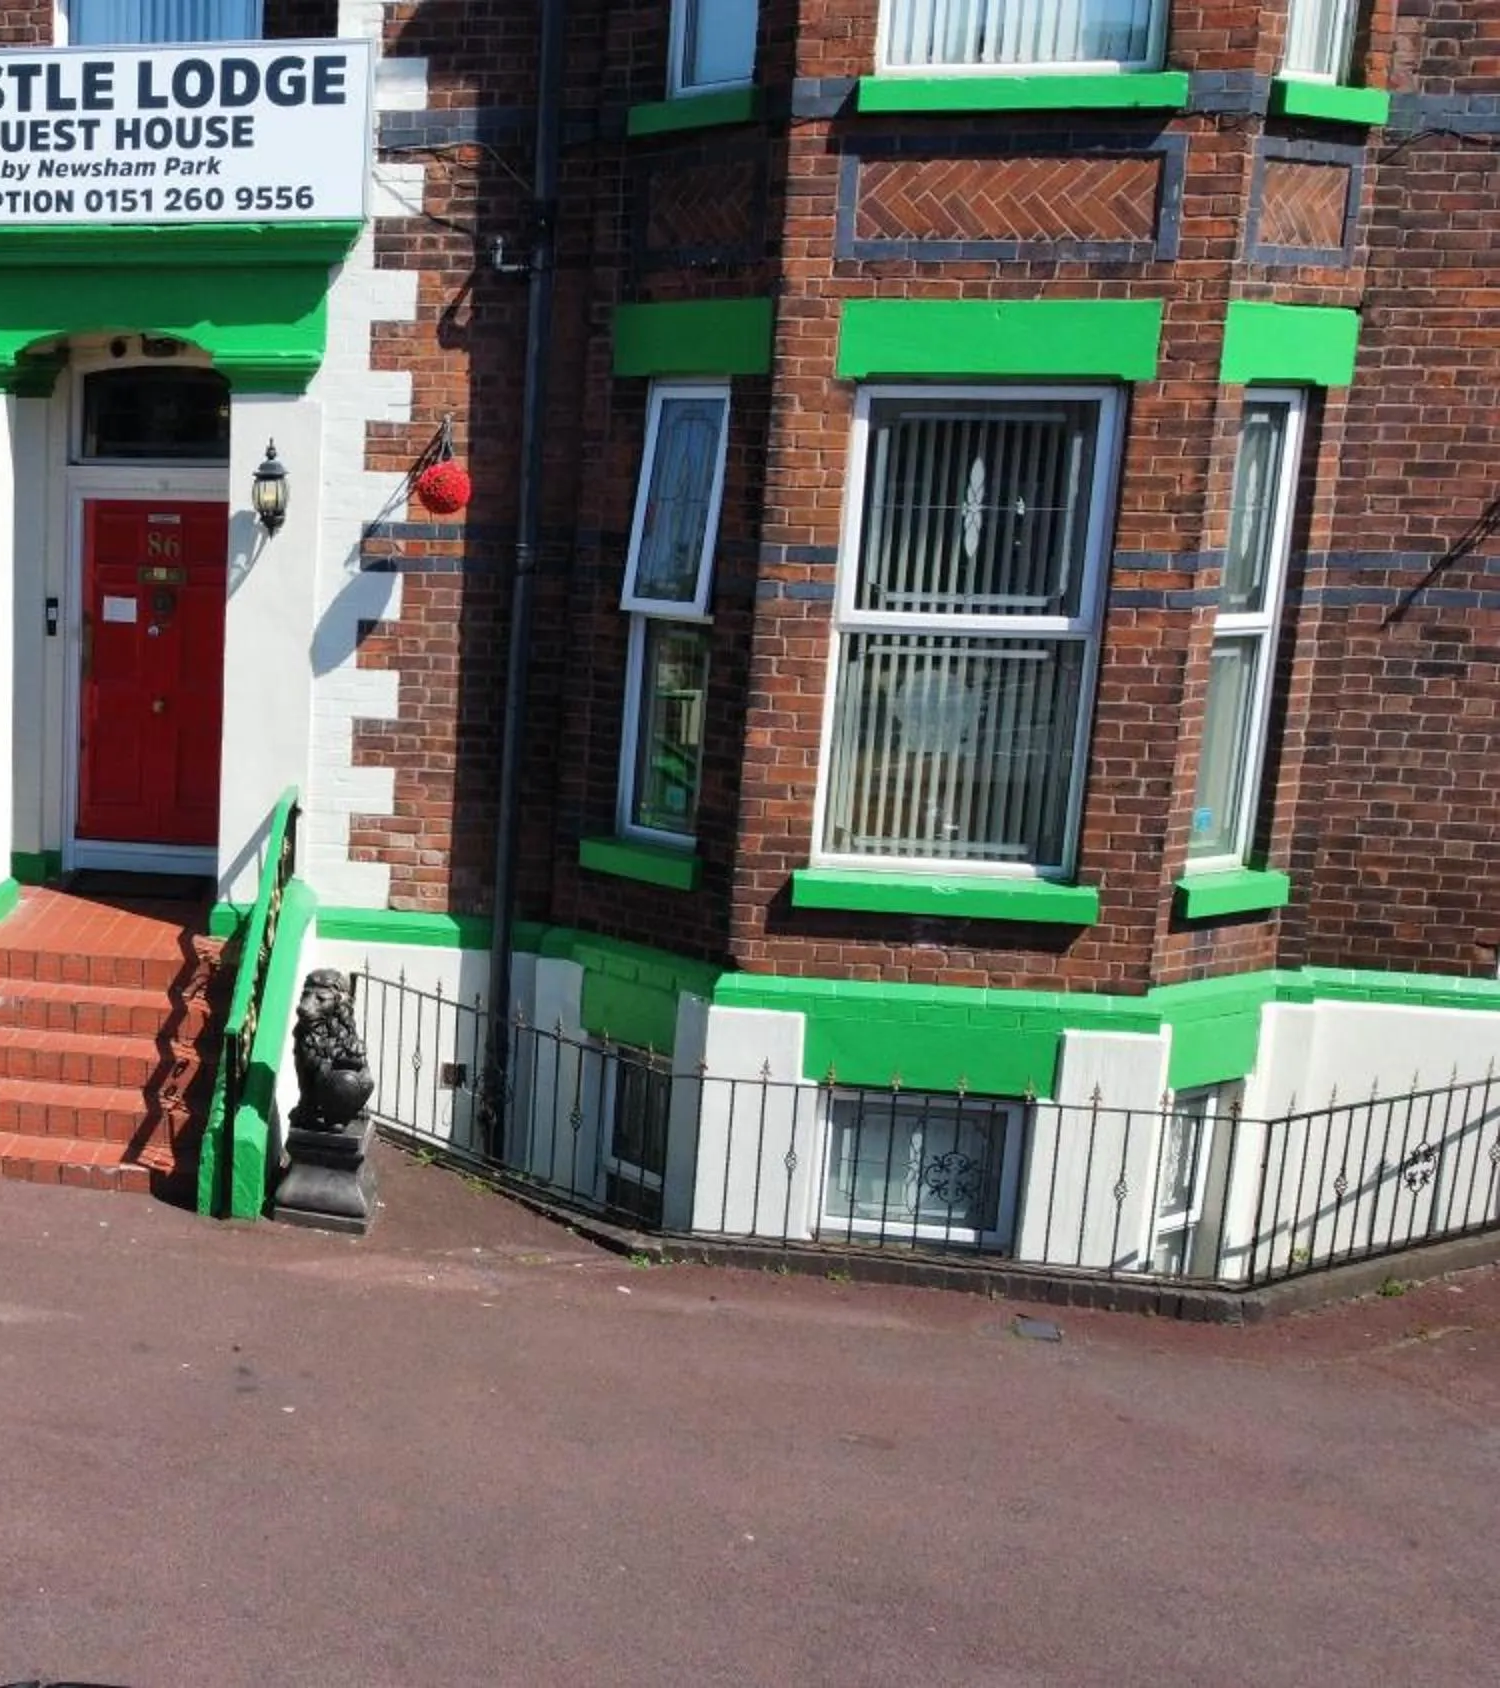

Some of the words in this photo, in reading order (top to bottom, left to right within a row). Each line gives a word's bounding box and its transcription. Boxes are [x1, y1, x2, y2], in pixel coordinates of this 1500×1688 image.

[137, 55, 347, 110] LODGE
[115, 115, 254, 151] HOUSE
[0, 159, 31, 181] by
[37, 157, 157, 178] Newsham
[163, 155, 222, 176] Park
[84, 188, 153, 213] 0151
[164, 187, 225, 212] 260
[235, 185, 314, 211] 9556
[147, 531, 180, 558] 86
